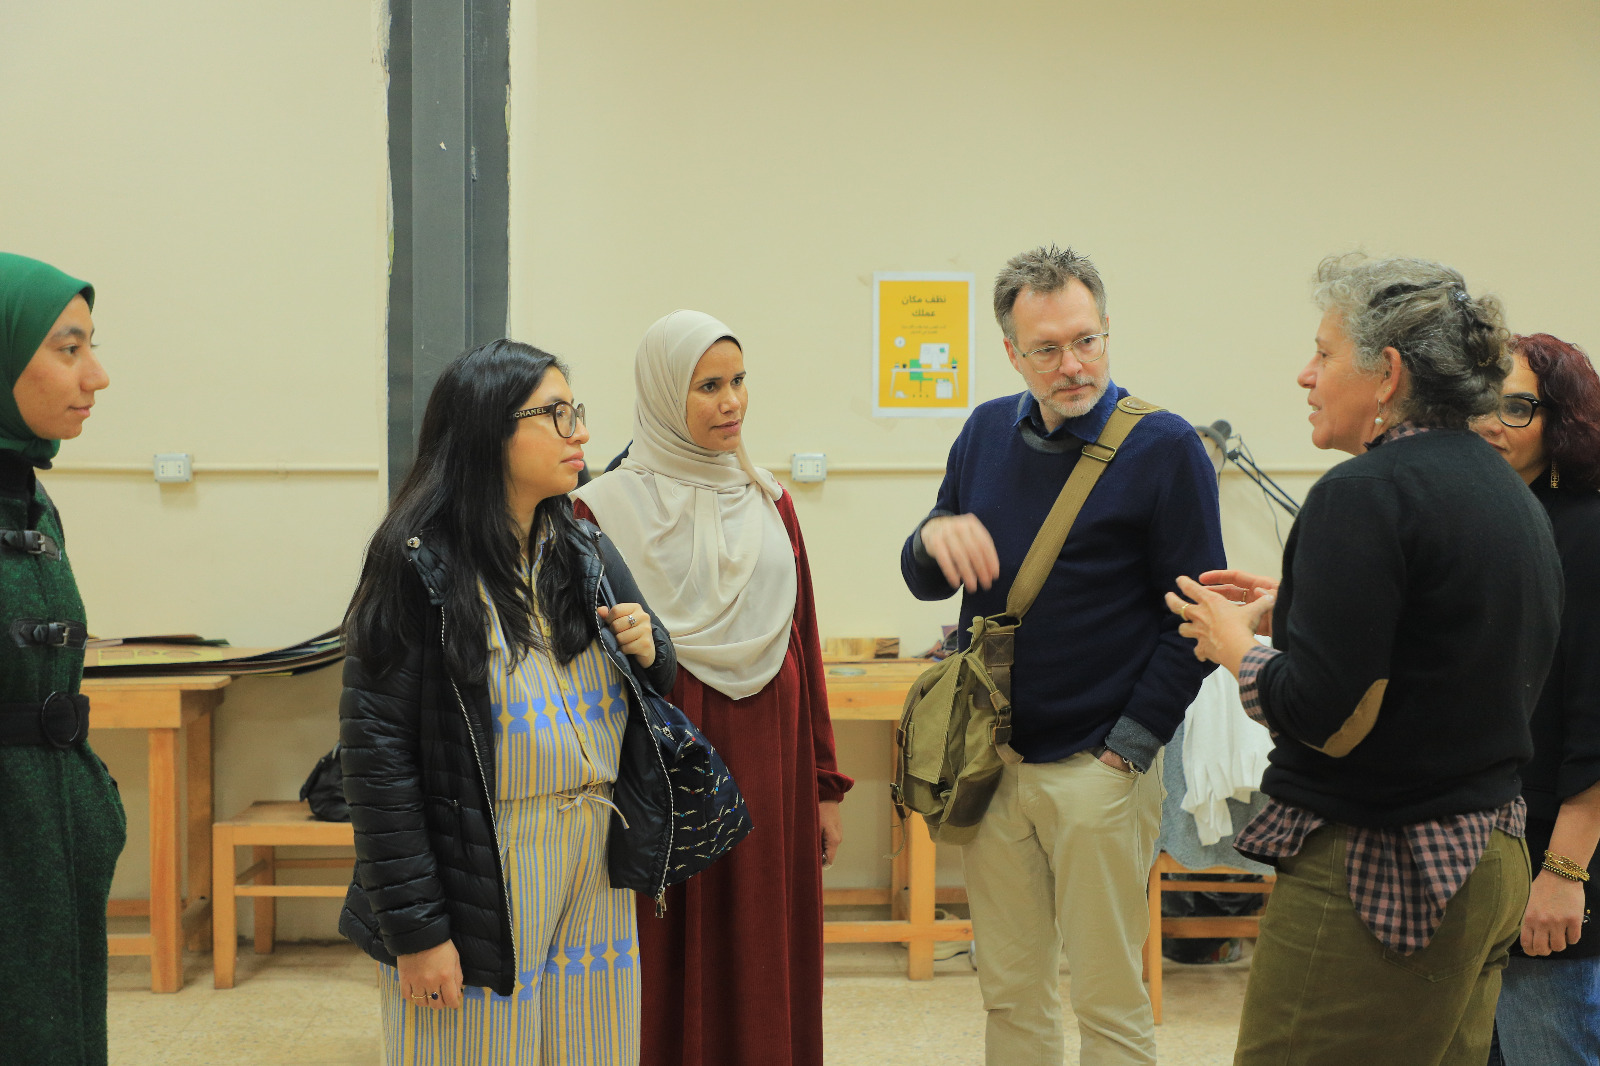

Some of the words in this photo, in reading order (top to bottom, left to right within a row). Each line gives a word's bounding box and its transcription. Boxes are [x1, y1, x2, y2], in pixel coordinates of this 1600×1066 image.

[902, 295, 922, 304] مكان
[912, 308, 935, 316] عملك
[514, 407, 547, 418] CHANEL
